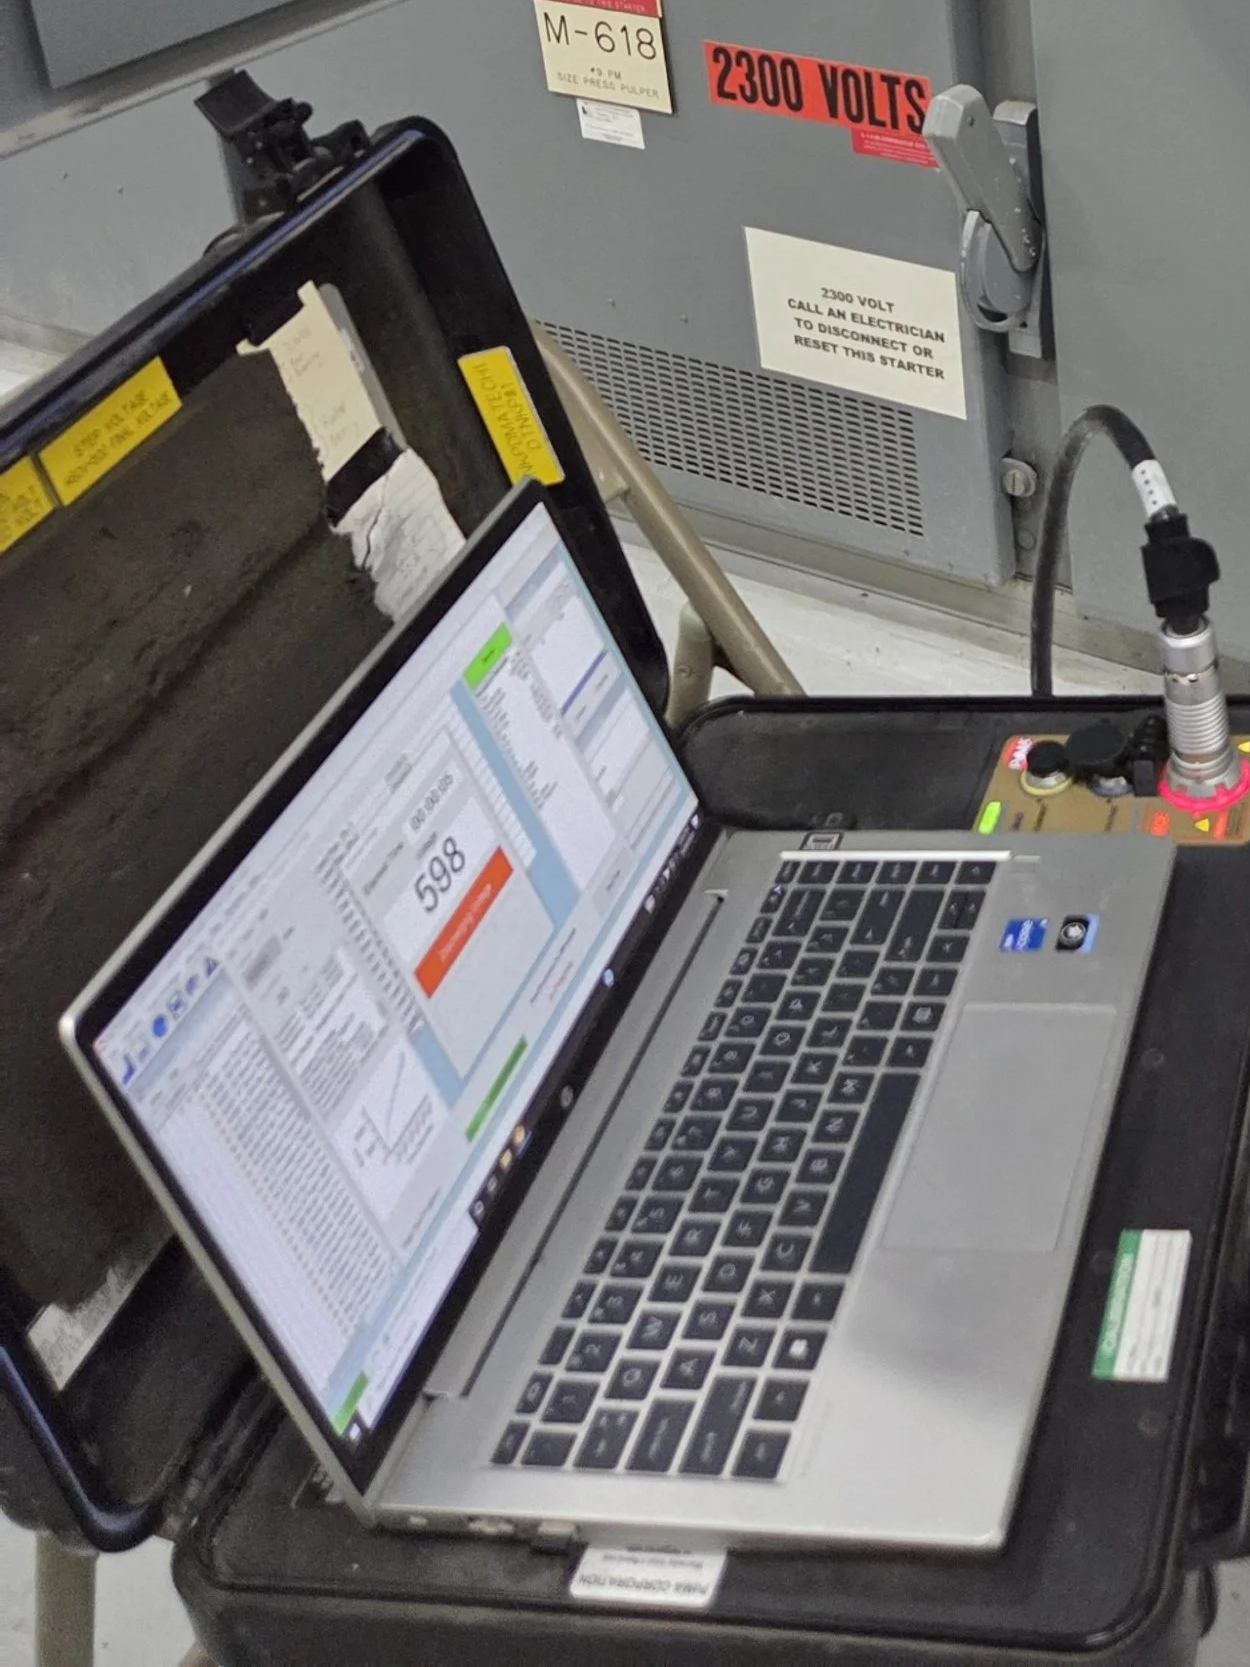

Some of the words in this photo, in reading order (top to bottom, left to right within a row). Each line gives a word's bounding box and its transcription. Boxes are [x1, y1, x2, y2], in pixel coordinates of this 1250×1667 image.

[544, 12, 656, 60] M-618
[557, 72, 579, 84] SIZE
[584, 77, 616, 91] PRESS
[620, 83, 660, 99] PULPER
[608, 69, 622, 80] PM
[712, 46, 804, 112] 2300
[818, 63, 925, 134] VOLTS
[787, 298, 823, 315] CALL
[827, 307, 846, 320] AN
[851, 312, 945, 343] ELECTRICIAN
[820, 287, 853, 303] 2300
[857, 295, 895, 313] VOLT
[794, 317, 813, 330] TO
[818, 323, 908, 353] DISCONNECT
[912, 345, 934, 359] OR
[794, 335, 839, 354] RESET
[842, 346, 875, 363] THIS
[880, 355, 945, 380] STARTER
[414, 835, 466, 914] 598
